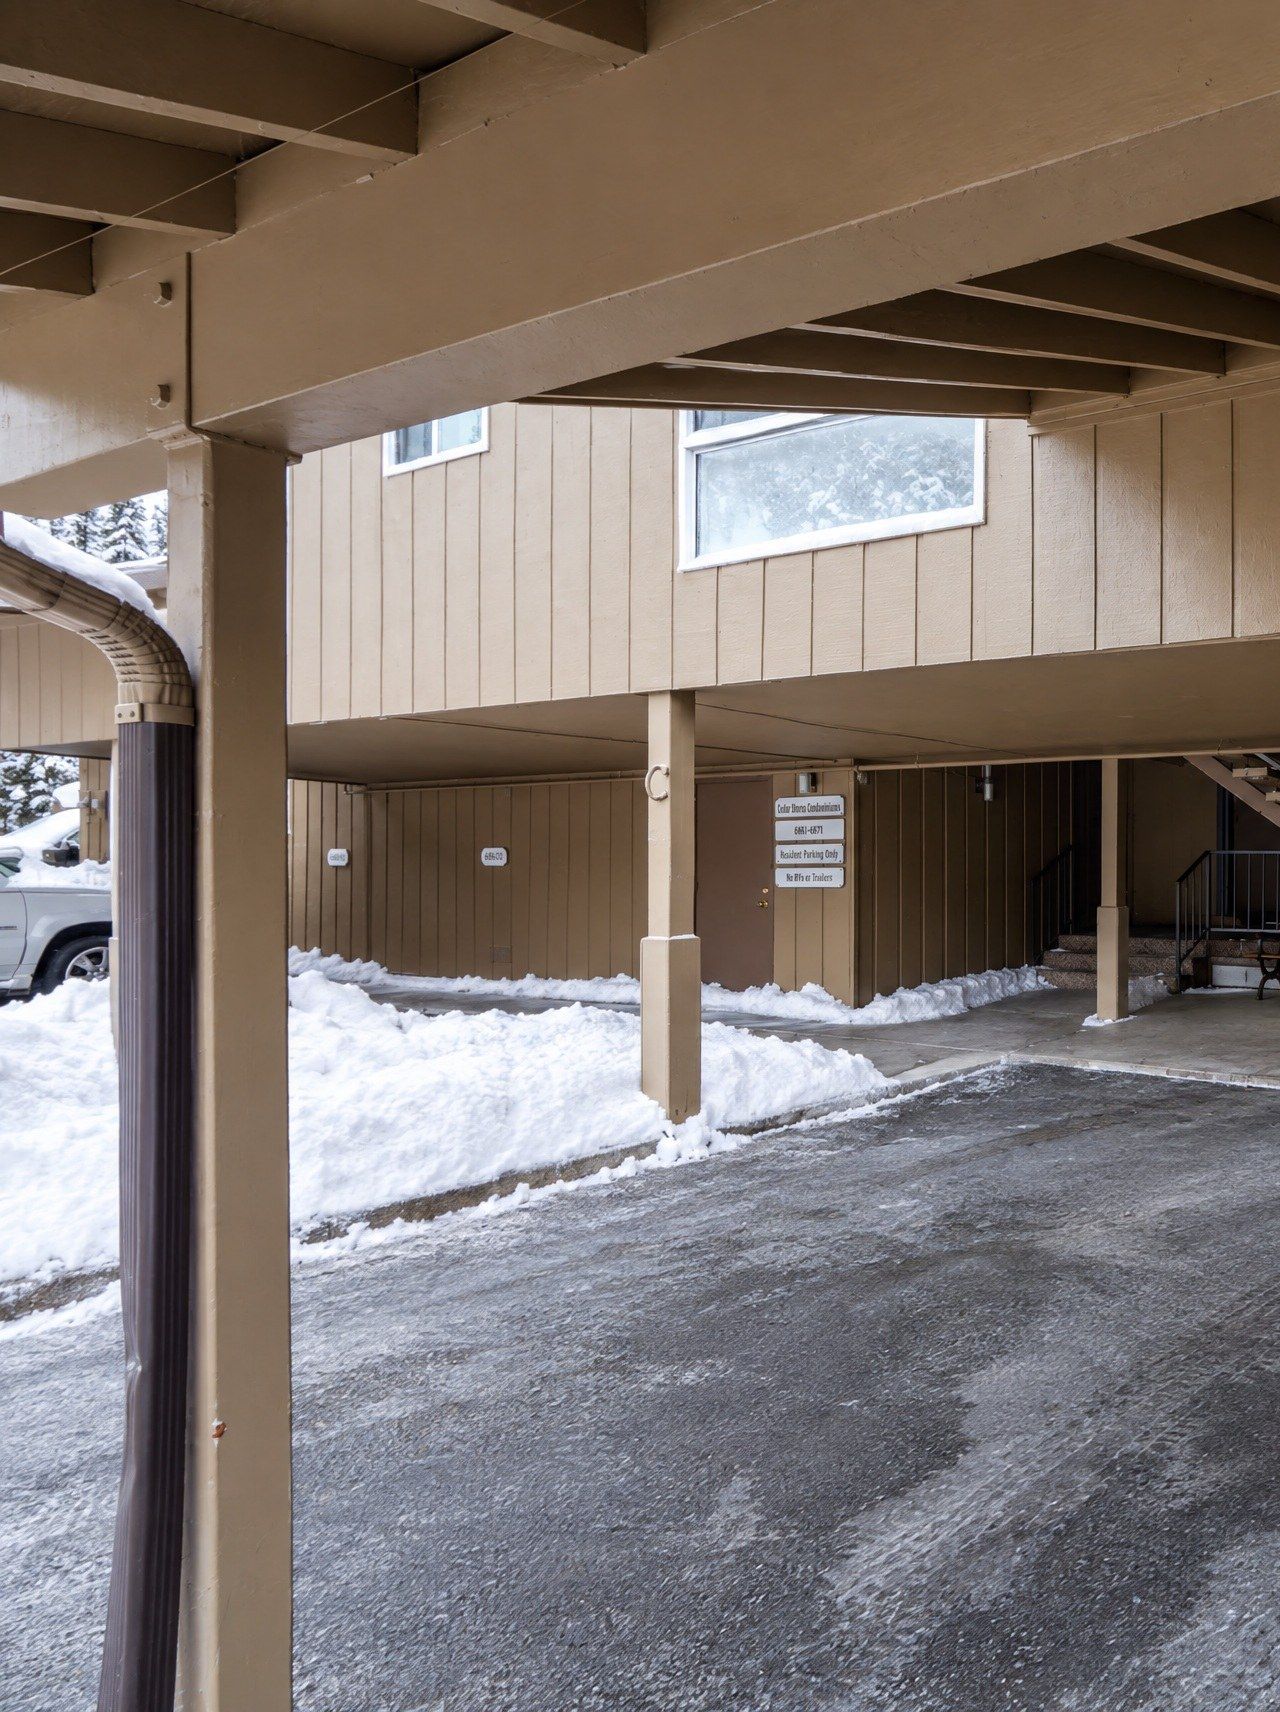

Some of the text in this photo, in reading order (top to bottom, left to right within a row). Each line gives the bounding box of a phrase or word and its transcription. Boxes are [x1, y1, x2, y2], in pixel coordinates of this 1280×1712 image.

[780, 849, 839, 861] Resident Parking Only
[786, 873, 794, 882] No
[812, 872, 833, 882] Trailers
